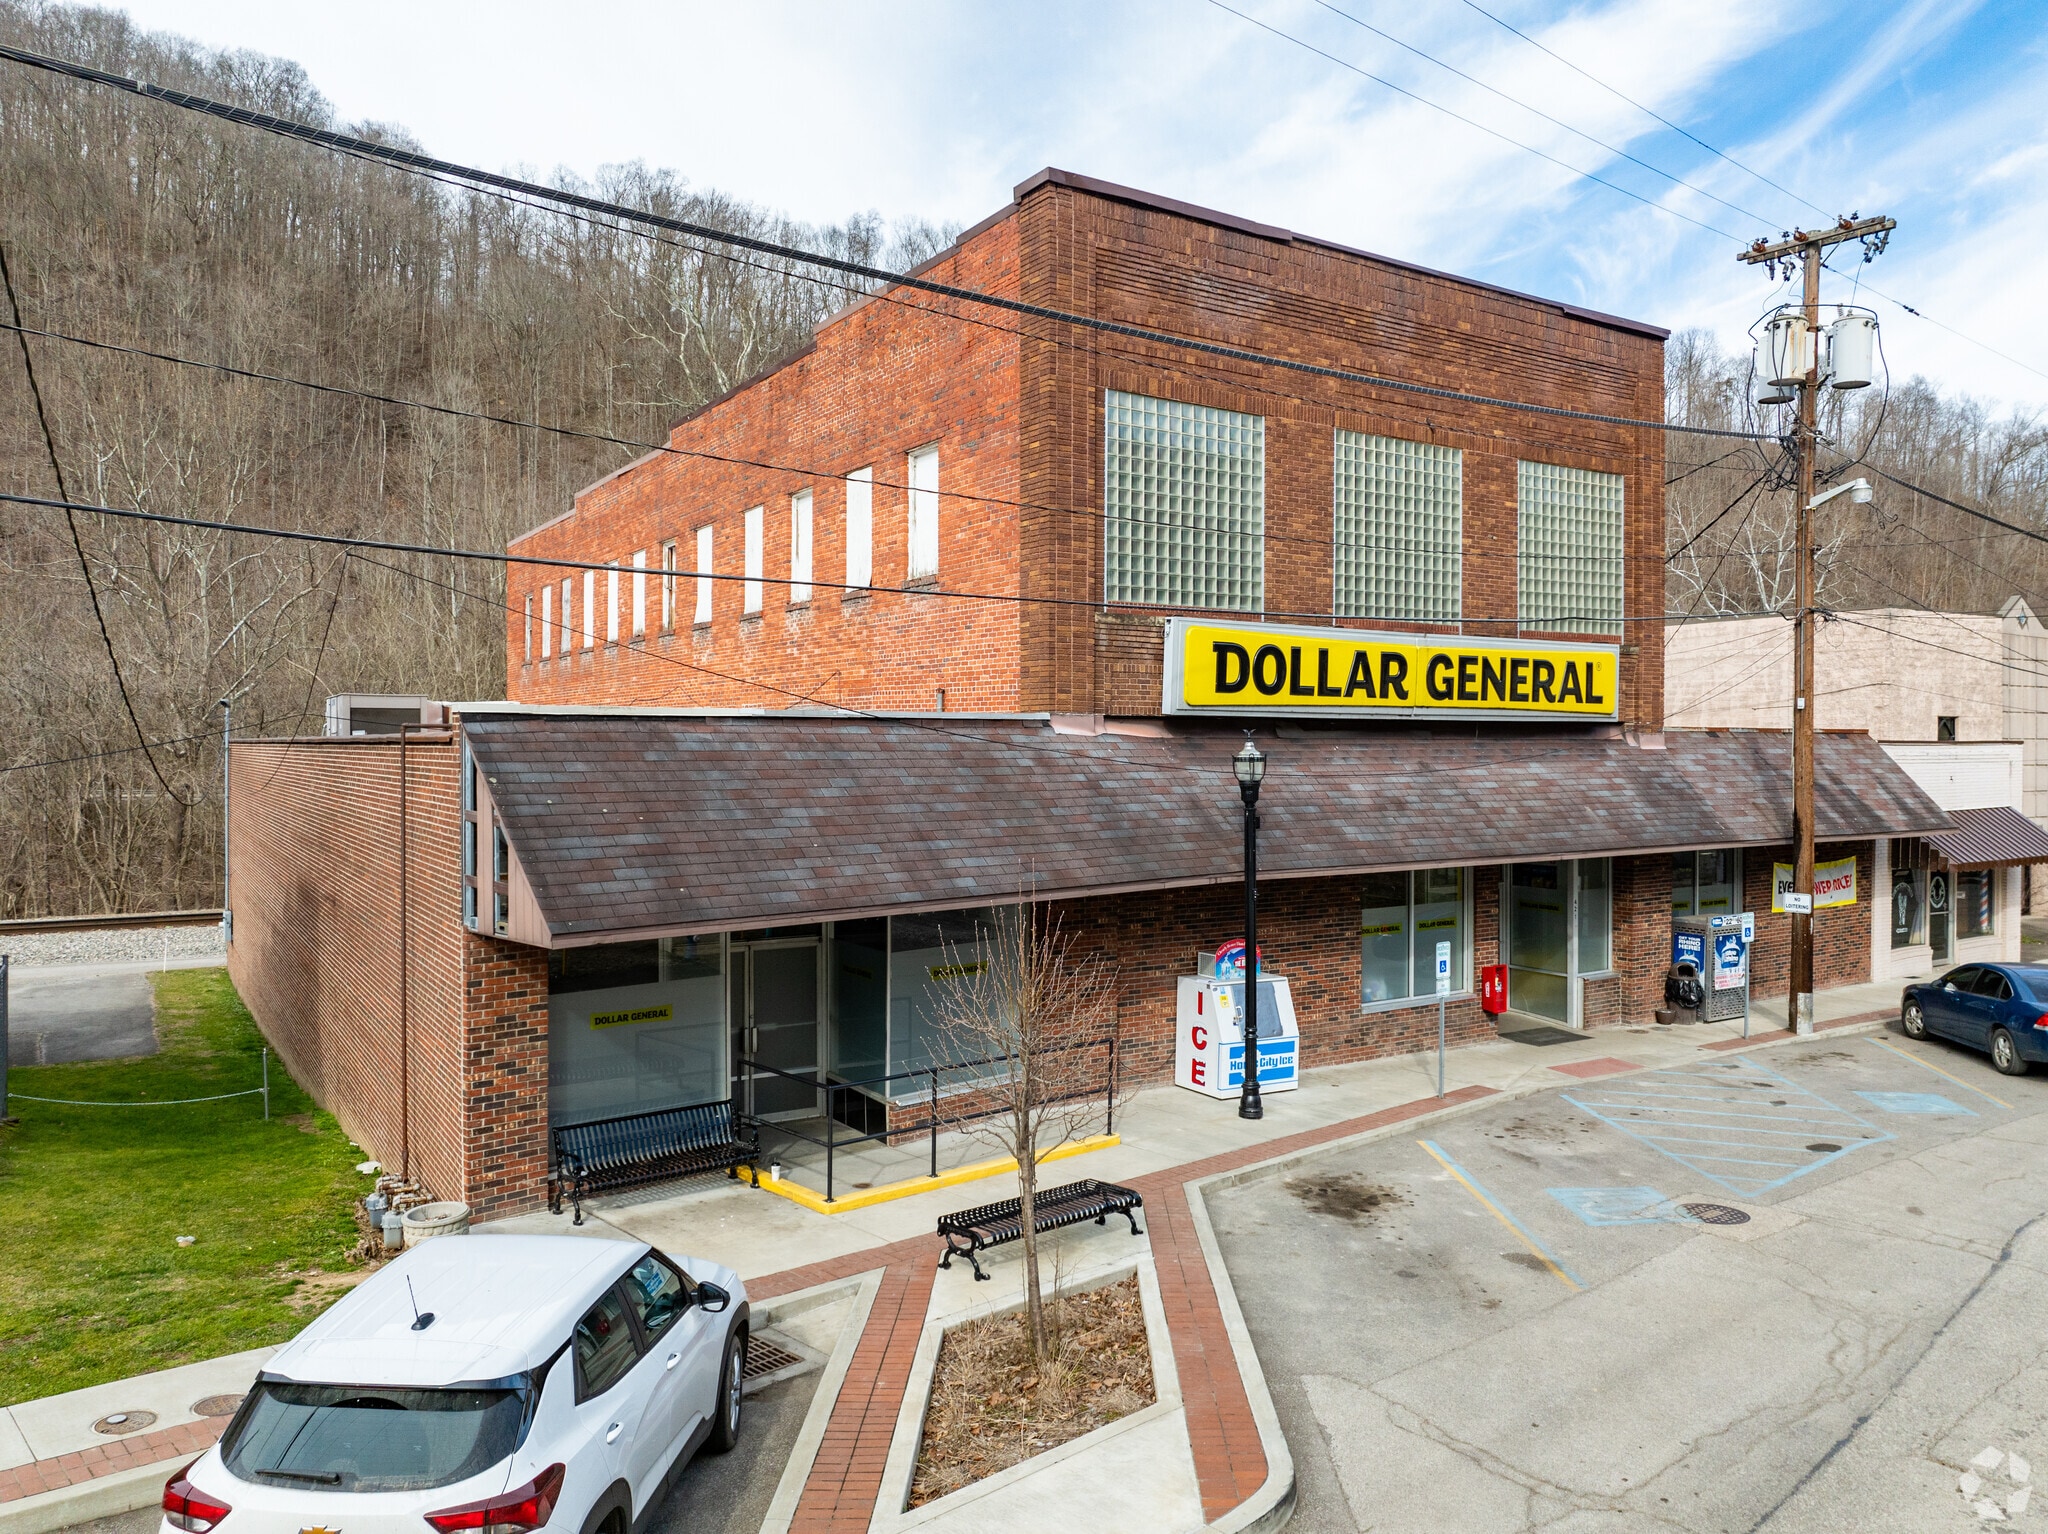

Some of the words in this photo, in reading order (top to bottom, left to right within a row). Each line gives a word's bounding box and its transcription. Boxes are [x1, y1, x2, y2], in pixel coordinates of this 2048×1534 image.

[1212, 640, 1409, 701] DOLLAR
[1426, 652, 1604, 705] GENERAL
[1418, 921, 1435, 929] DOLLAR
[594, 1014, 629, 1026] DOLLAR
[631, 1009, 669, 1021] GENERAL
[1259, 1056, 1278, 1068] City
[1279, 1055, 1293, 1065] Ice
